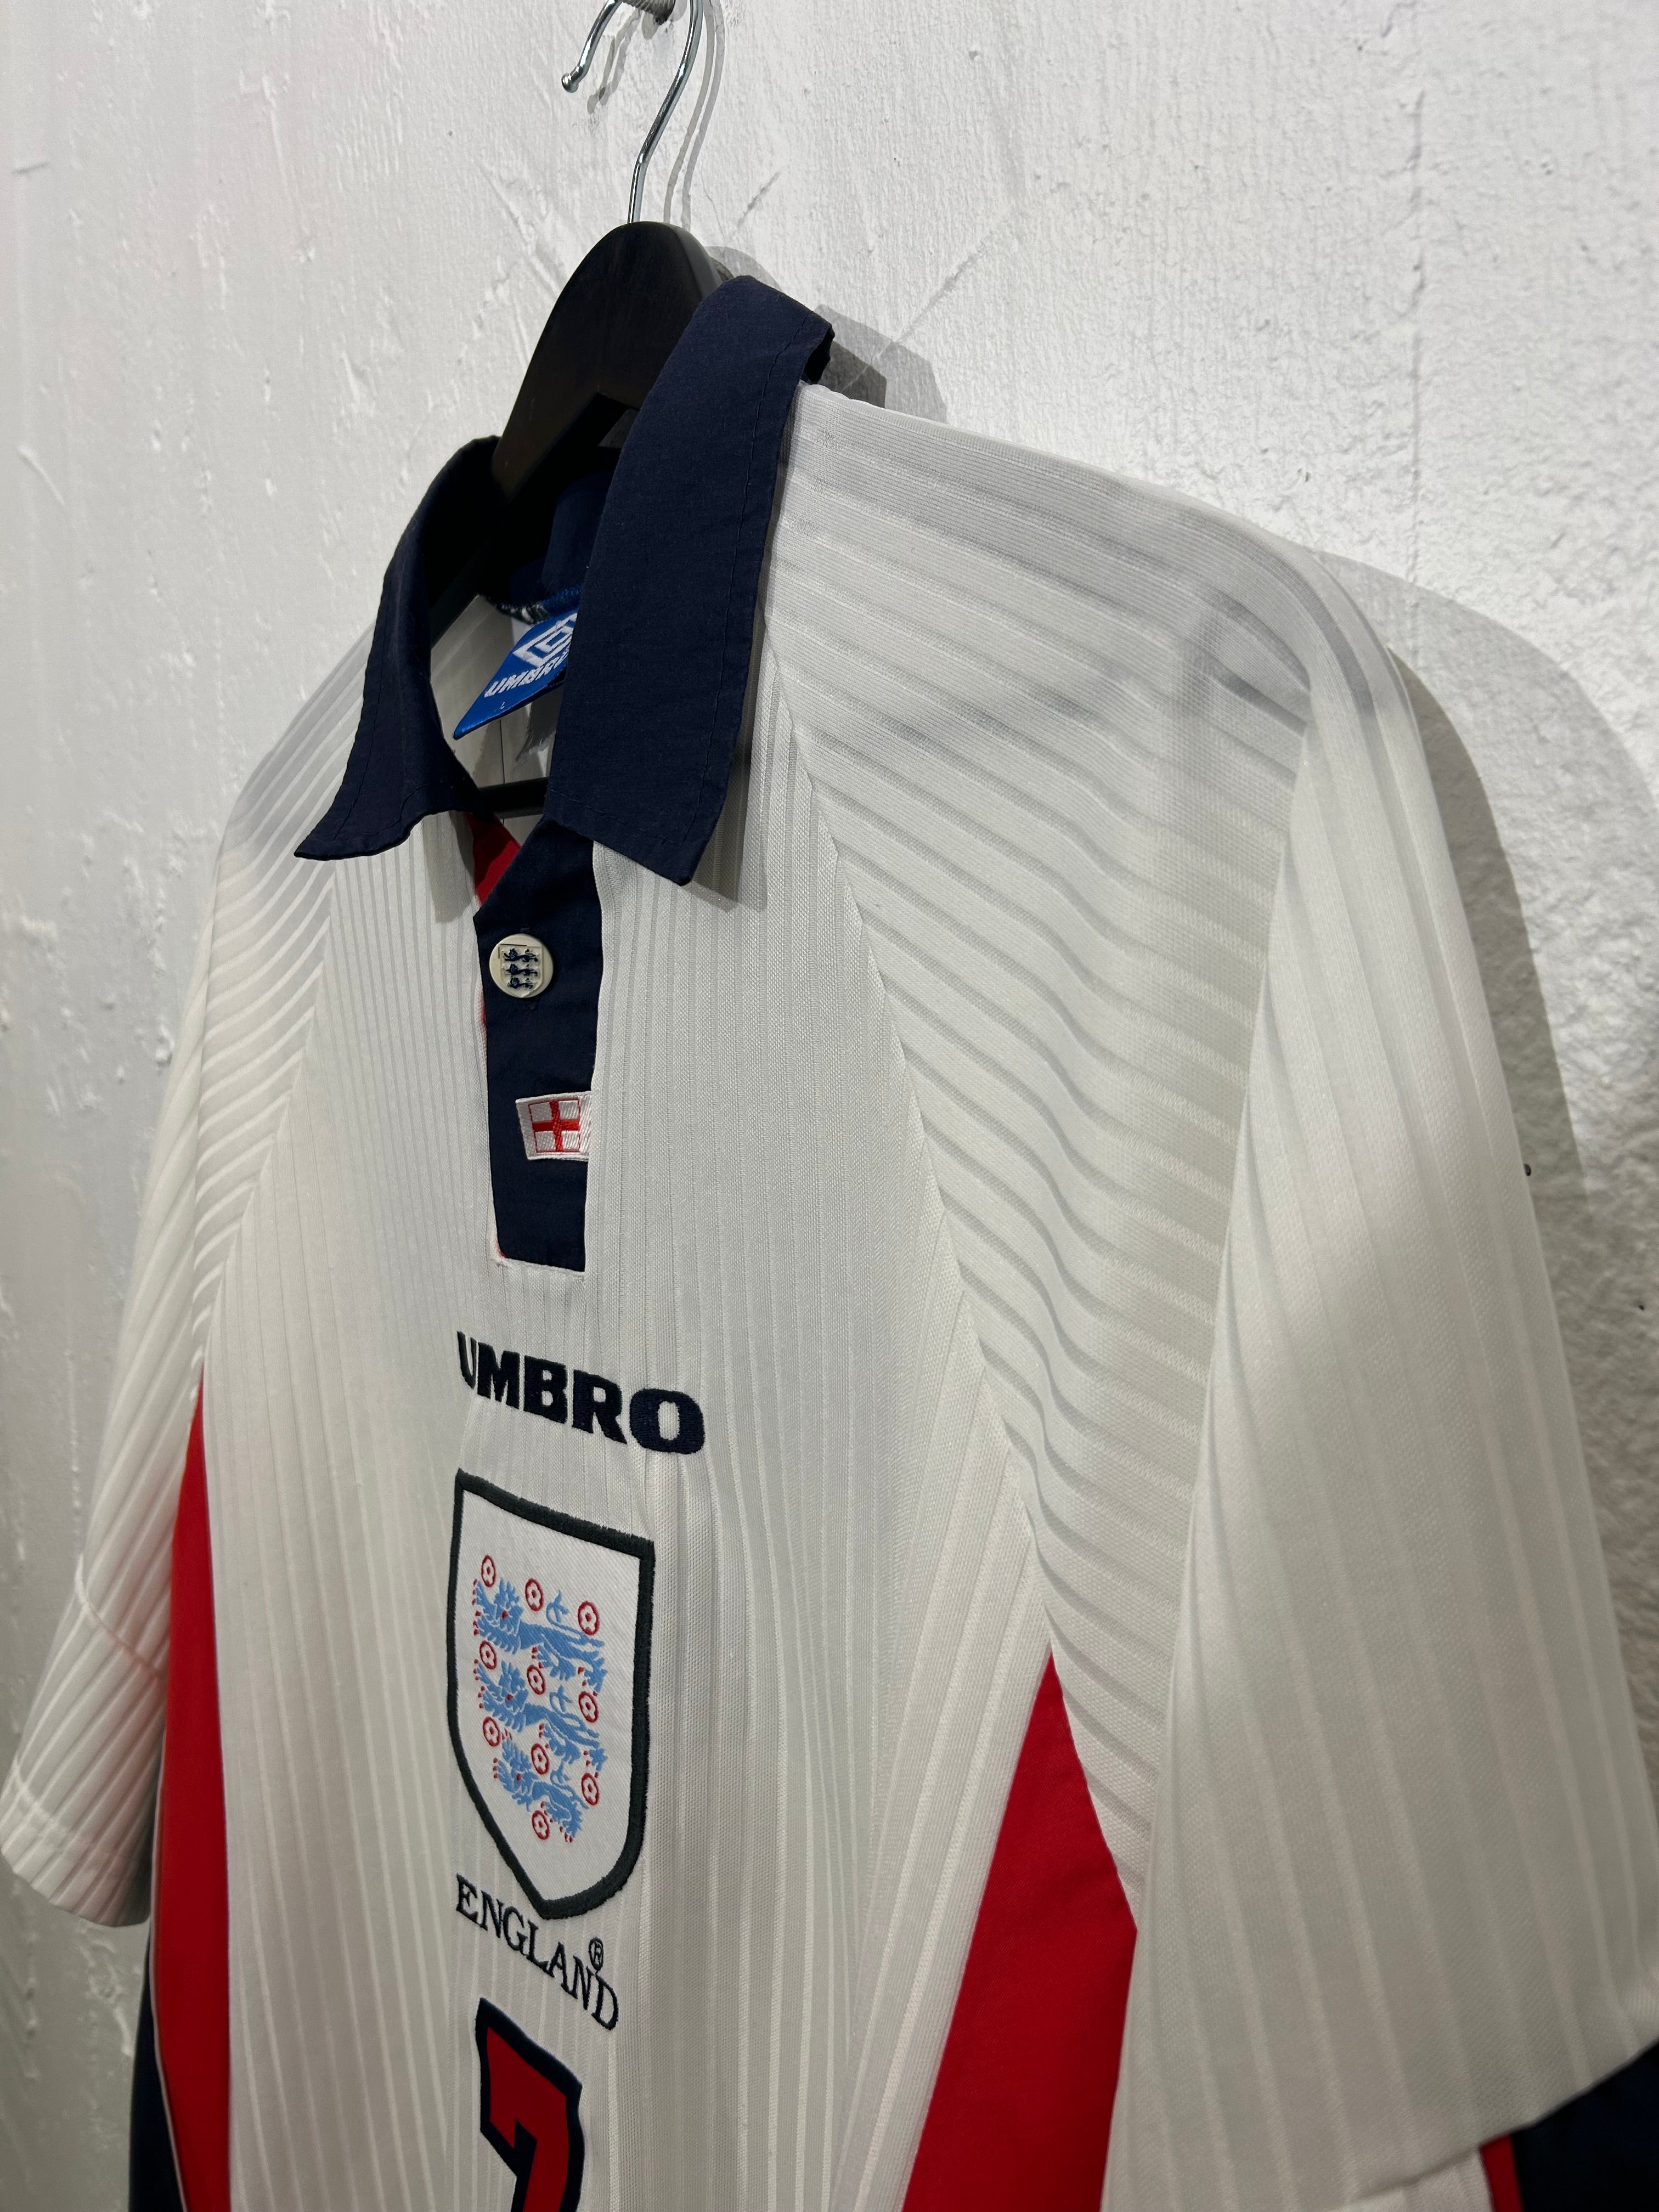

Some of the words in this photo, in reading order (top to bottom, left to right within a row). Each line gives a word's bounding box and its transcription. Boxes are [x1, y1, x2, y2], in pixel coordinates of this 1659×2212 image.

[456, 1330, 706, 1454] UMBRO
[456, 1872, 619, 2030] ENGLAND
[475, 1997, 585, 2212] 7
